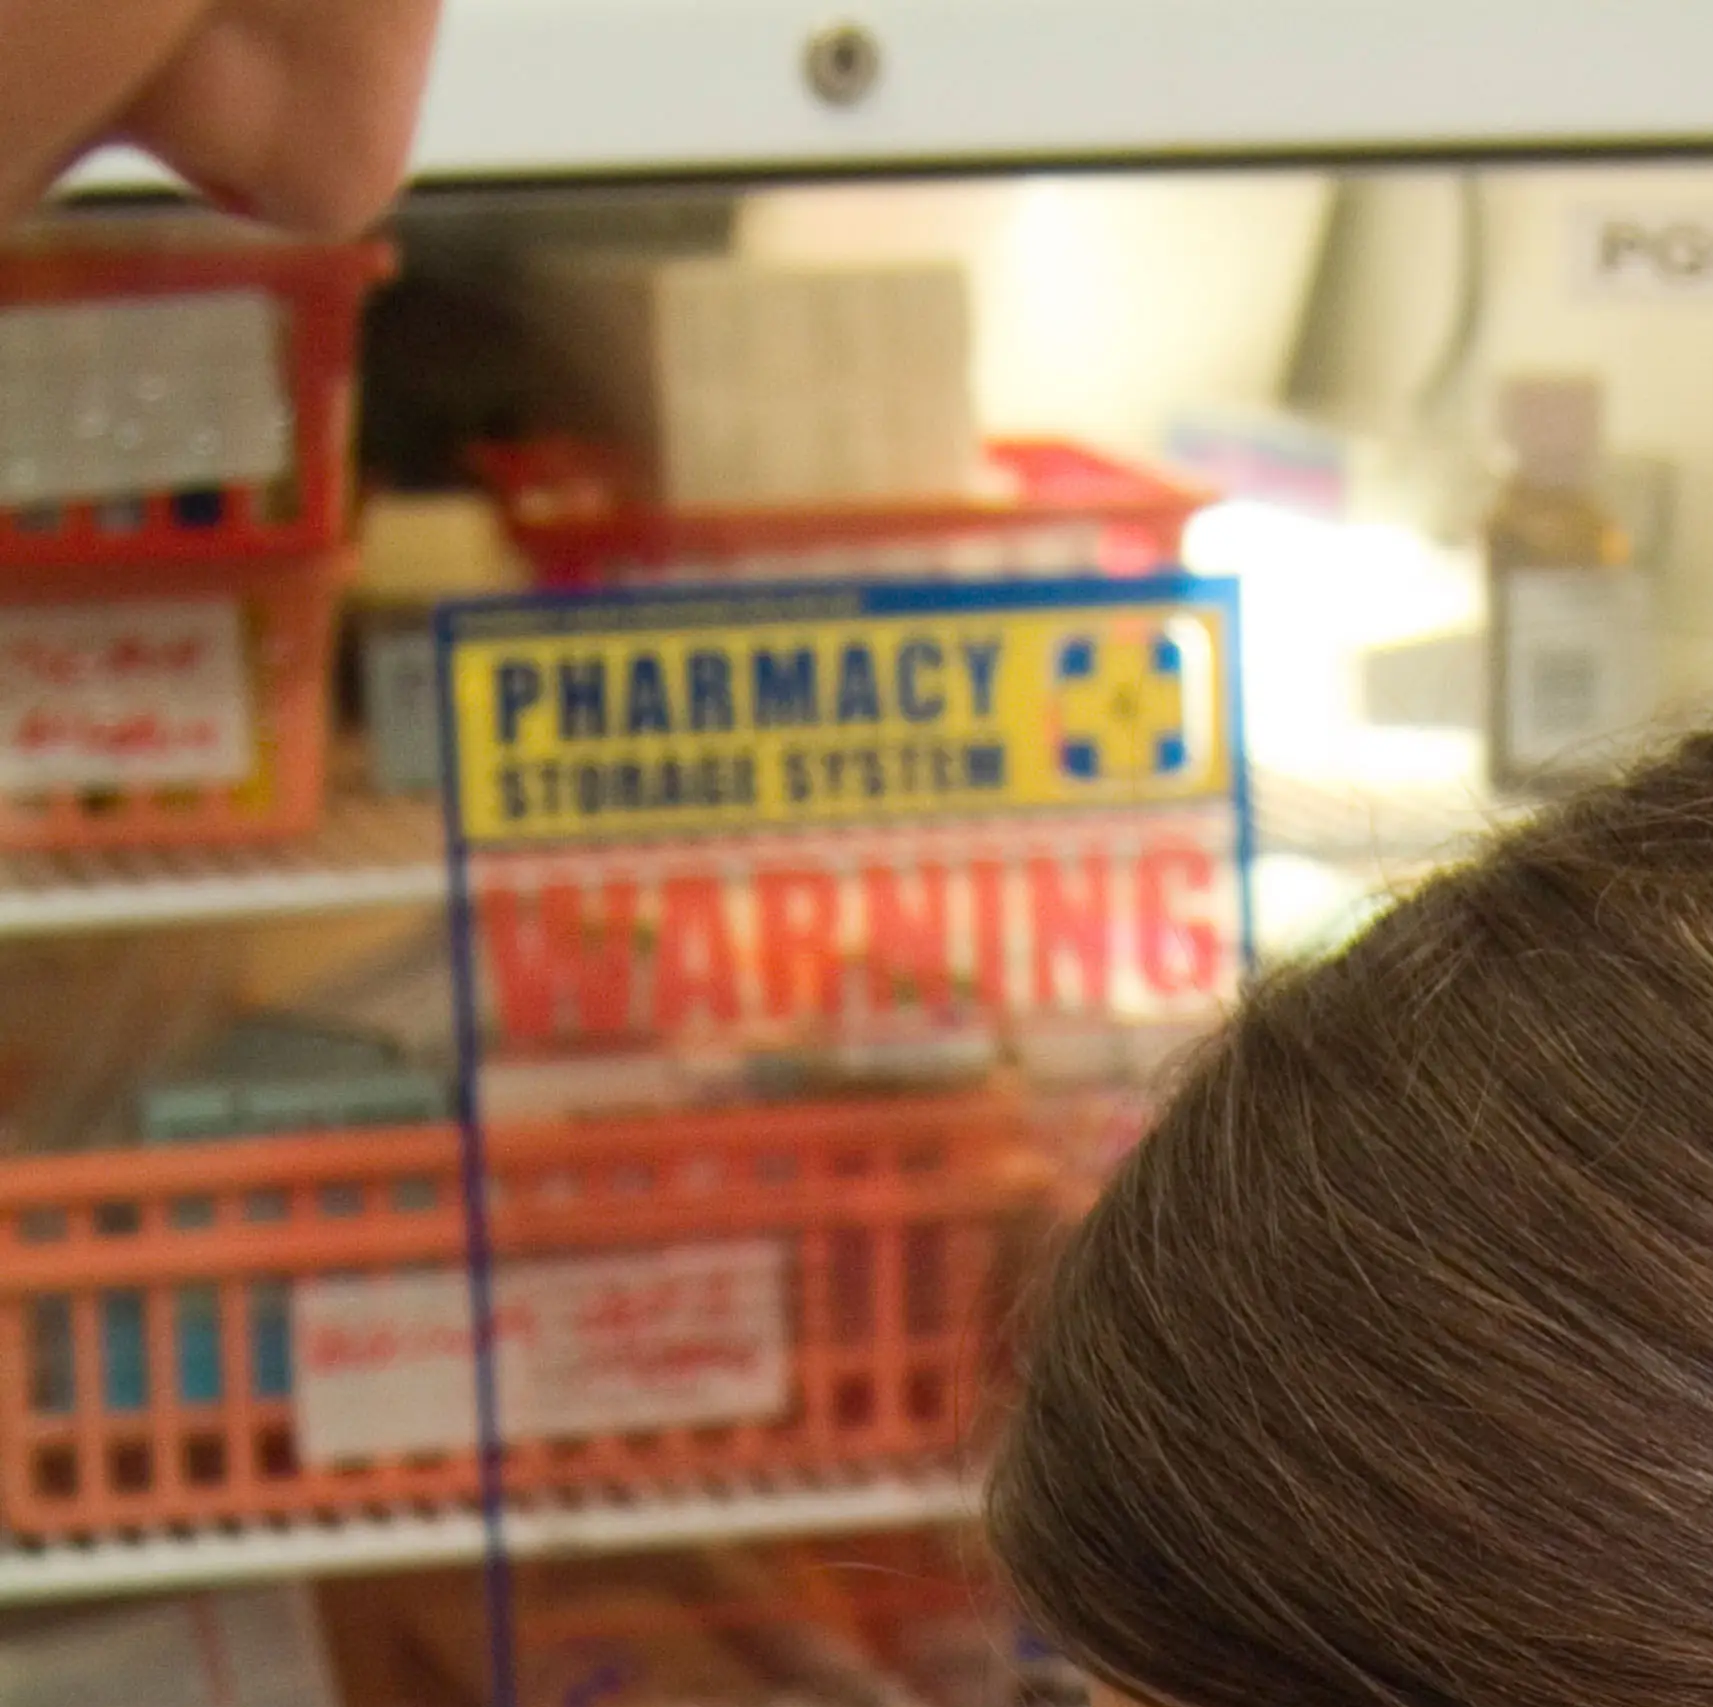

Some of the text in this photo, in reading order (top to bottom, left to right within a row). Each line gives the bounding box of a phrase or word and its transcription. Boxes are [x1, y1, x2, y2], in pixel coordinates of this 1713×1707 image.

[491, 641, 1006, 745] PHARMACY
[493, 742, 1007, 820] STORAGE SYSTEM
[480, 846, 1221, 1038] WARNING
